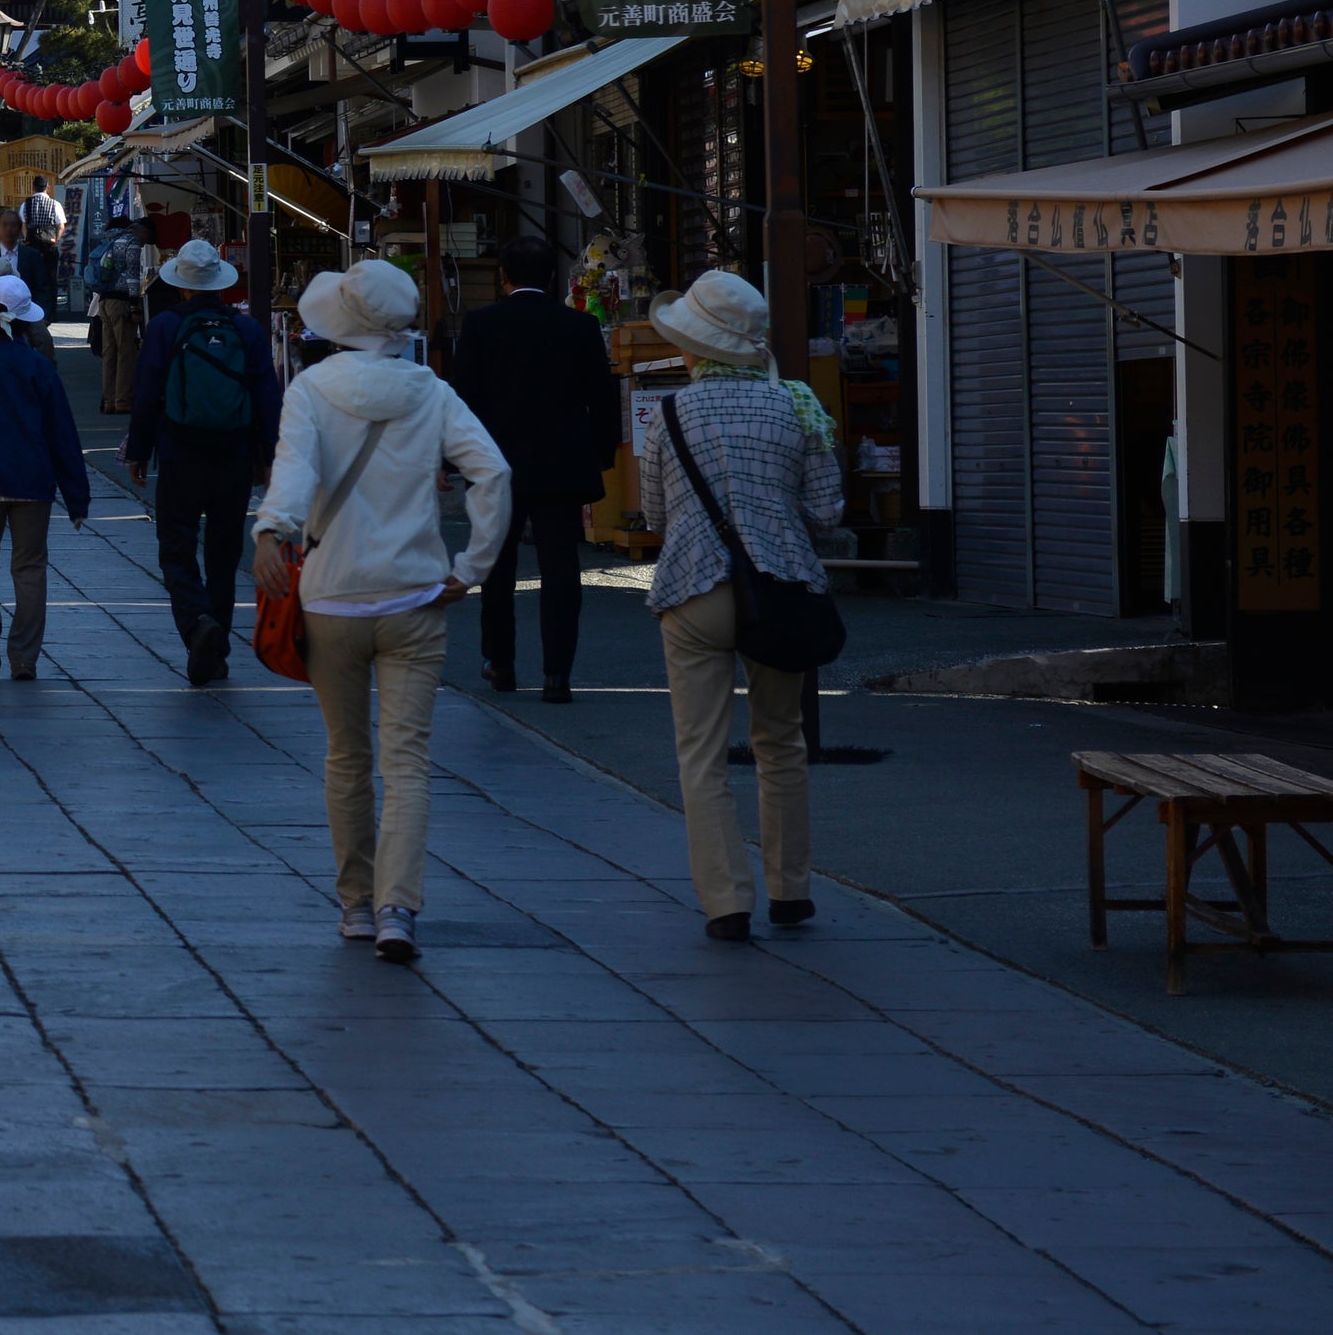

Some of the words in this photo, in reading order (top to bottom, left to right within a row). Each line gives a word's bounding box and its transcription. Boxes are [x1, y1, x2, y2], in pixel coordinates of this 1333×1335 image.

[596, 0, 737, 27] 元善町商盛会
